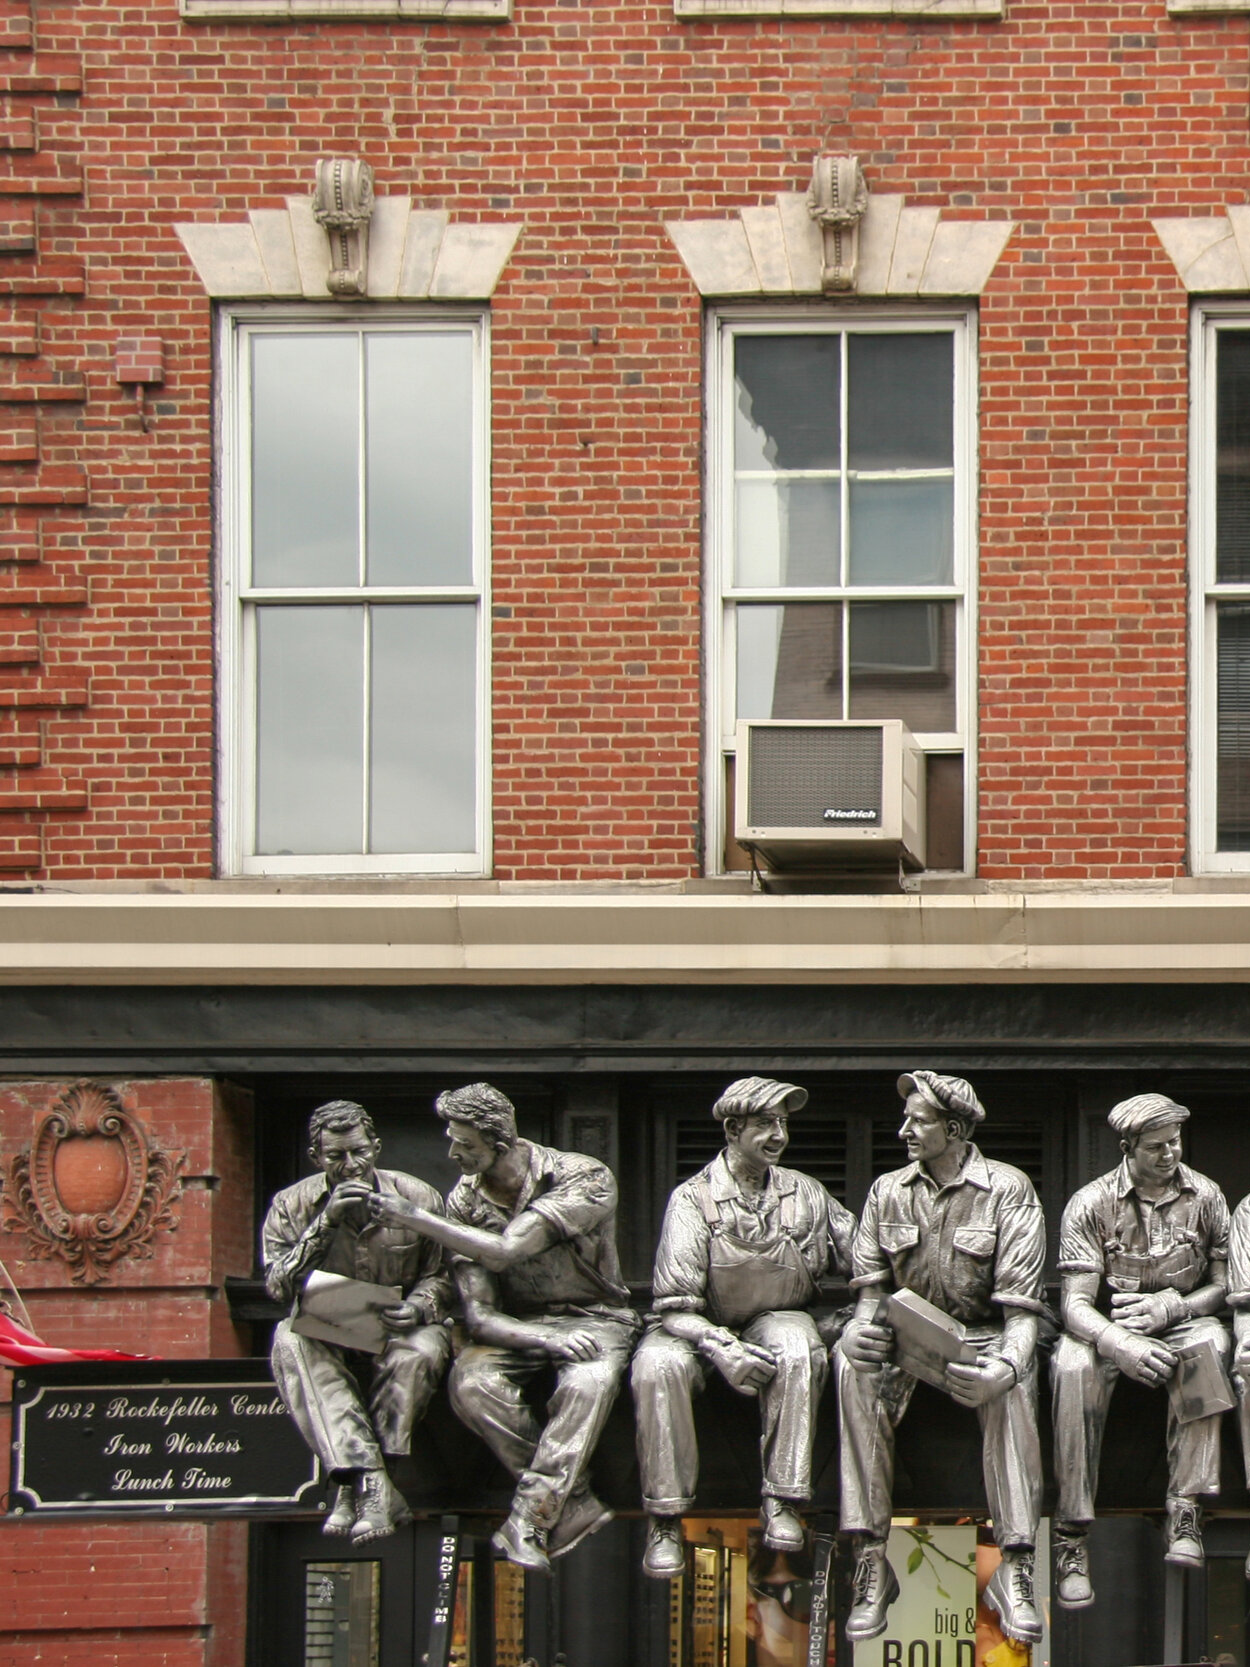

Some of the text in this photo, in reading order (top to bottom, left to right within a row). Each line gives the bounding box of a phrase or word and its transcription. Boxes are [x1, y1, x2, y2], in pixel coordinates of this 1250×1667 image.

[824, 809, 876, 819] Friedrich
[46, 1394, 291, 1426] 1932 Rockefeller Cente
[104, 1432, 242, 1455] Iron Workers
[111, 1467, 232, 1490] Lunch Time
[434, 1536, 455, 1623] DO NOT CLIMB
[814, 1571, 825, 1585] DO
[934, 1607, 976, 1638] big &
